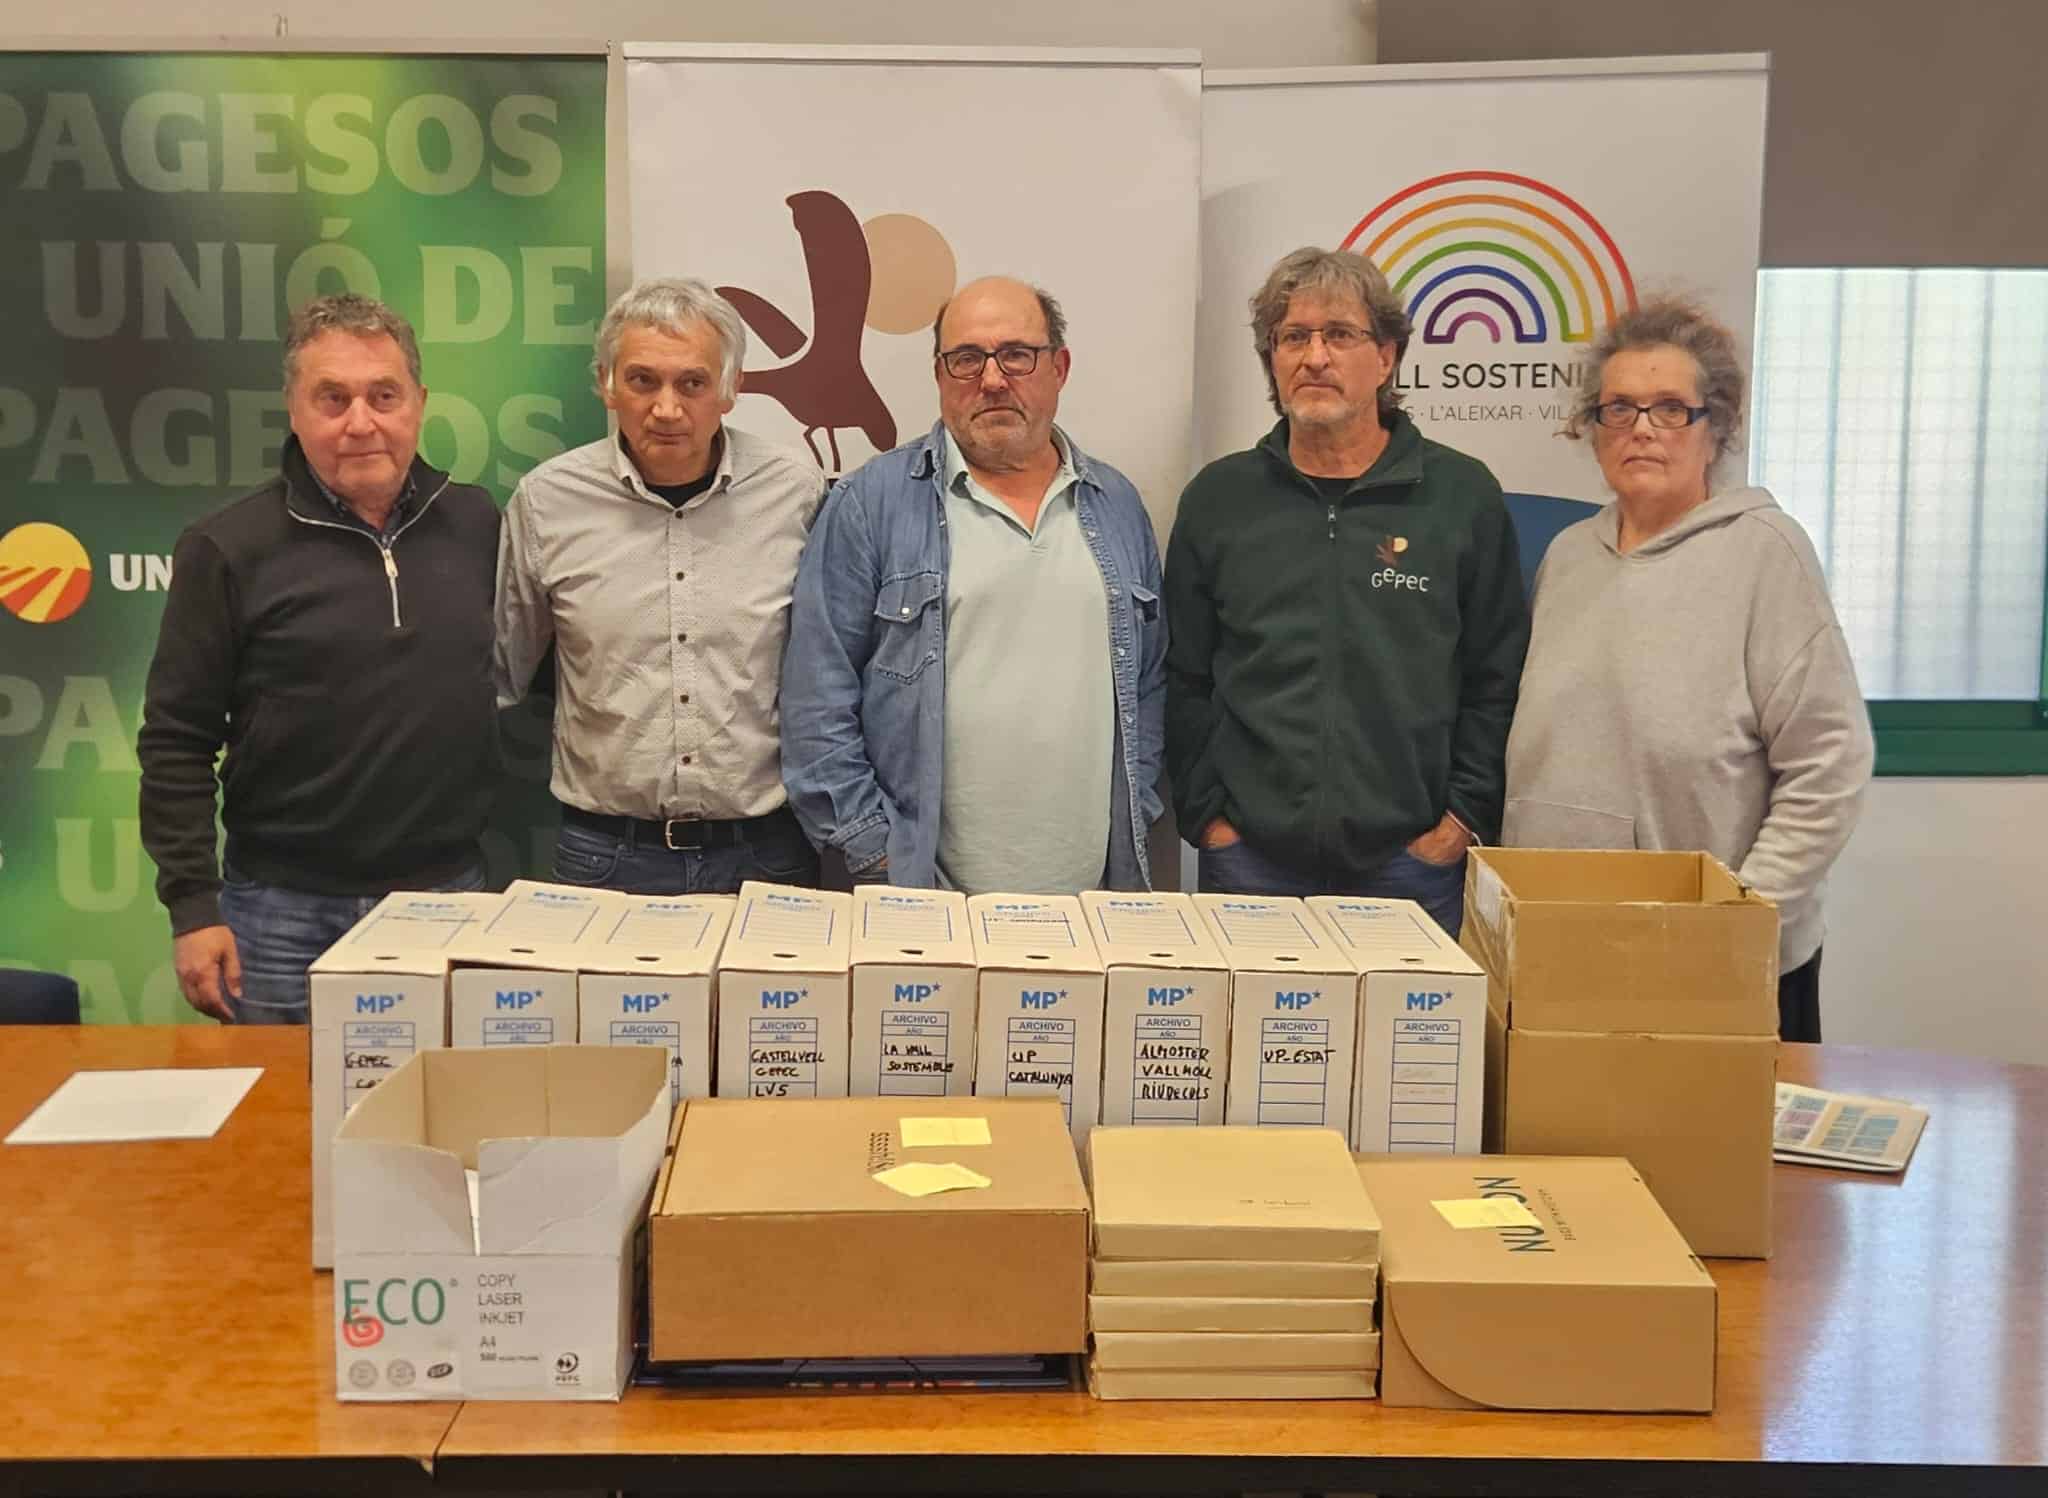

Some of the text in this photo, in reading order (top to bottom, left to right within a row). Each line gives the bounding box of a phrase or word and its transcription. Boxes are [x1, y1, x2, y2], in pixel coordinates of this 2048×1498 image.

[41, 218, 595, 345] UNIÓ DE
[1393, 363, 1582, 389] LL SOSTENI
[1430, 405, 1523, 421] L'ALEIXAR
[109, 554, 174, 591] UN
[760, 1021, 807, 1031] ARCHIVO
[892, 1014, 938, 1025] ARCHIVO
[1019, 1021, 1065, 1031] ARCHIVO
[1146, 1018, 1192, 1028] ARCHIVO
[620, 1025, 668, 1035] ARCHIVO
[1272, 1022, 1318, 1032] ARCHIVO
[1403, 1022, 1450, 1032] ARCHIVO
[884, 1042, 932, 1056] LA VALL
[1012, 1049, 1037, 1063] UP
[1141, 1044, 1210, 1062] ALMOSTER
[477, 1273, 516, 1288] COPY
[342, 1277, 446, 1326] ECO
[478, 1291, 523, 1306] LASER
[479, 1310, 524, 1325] INKJET
